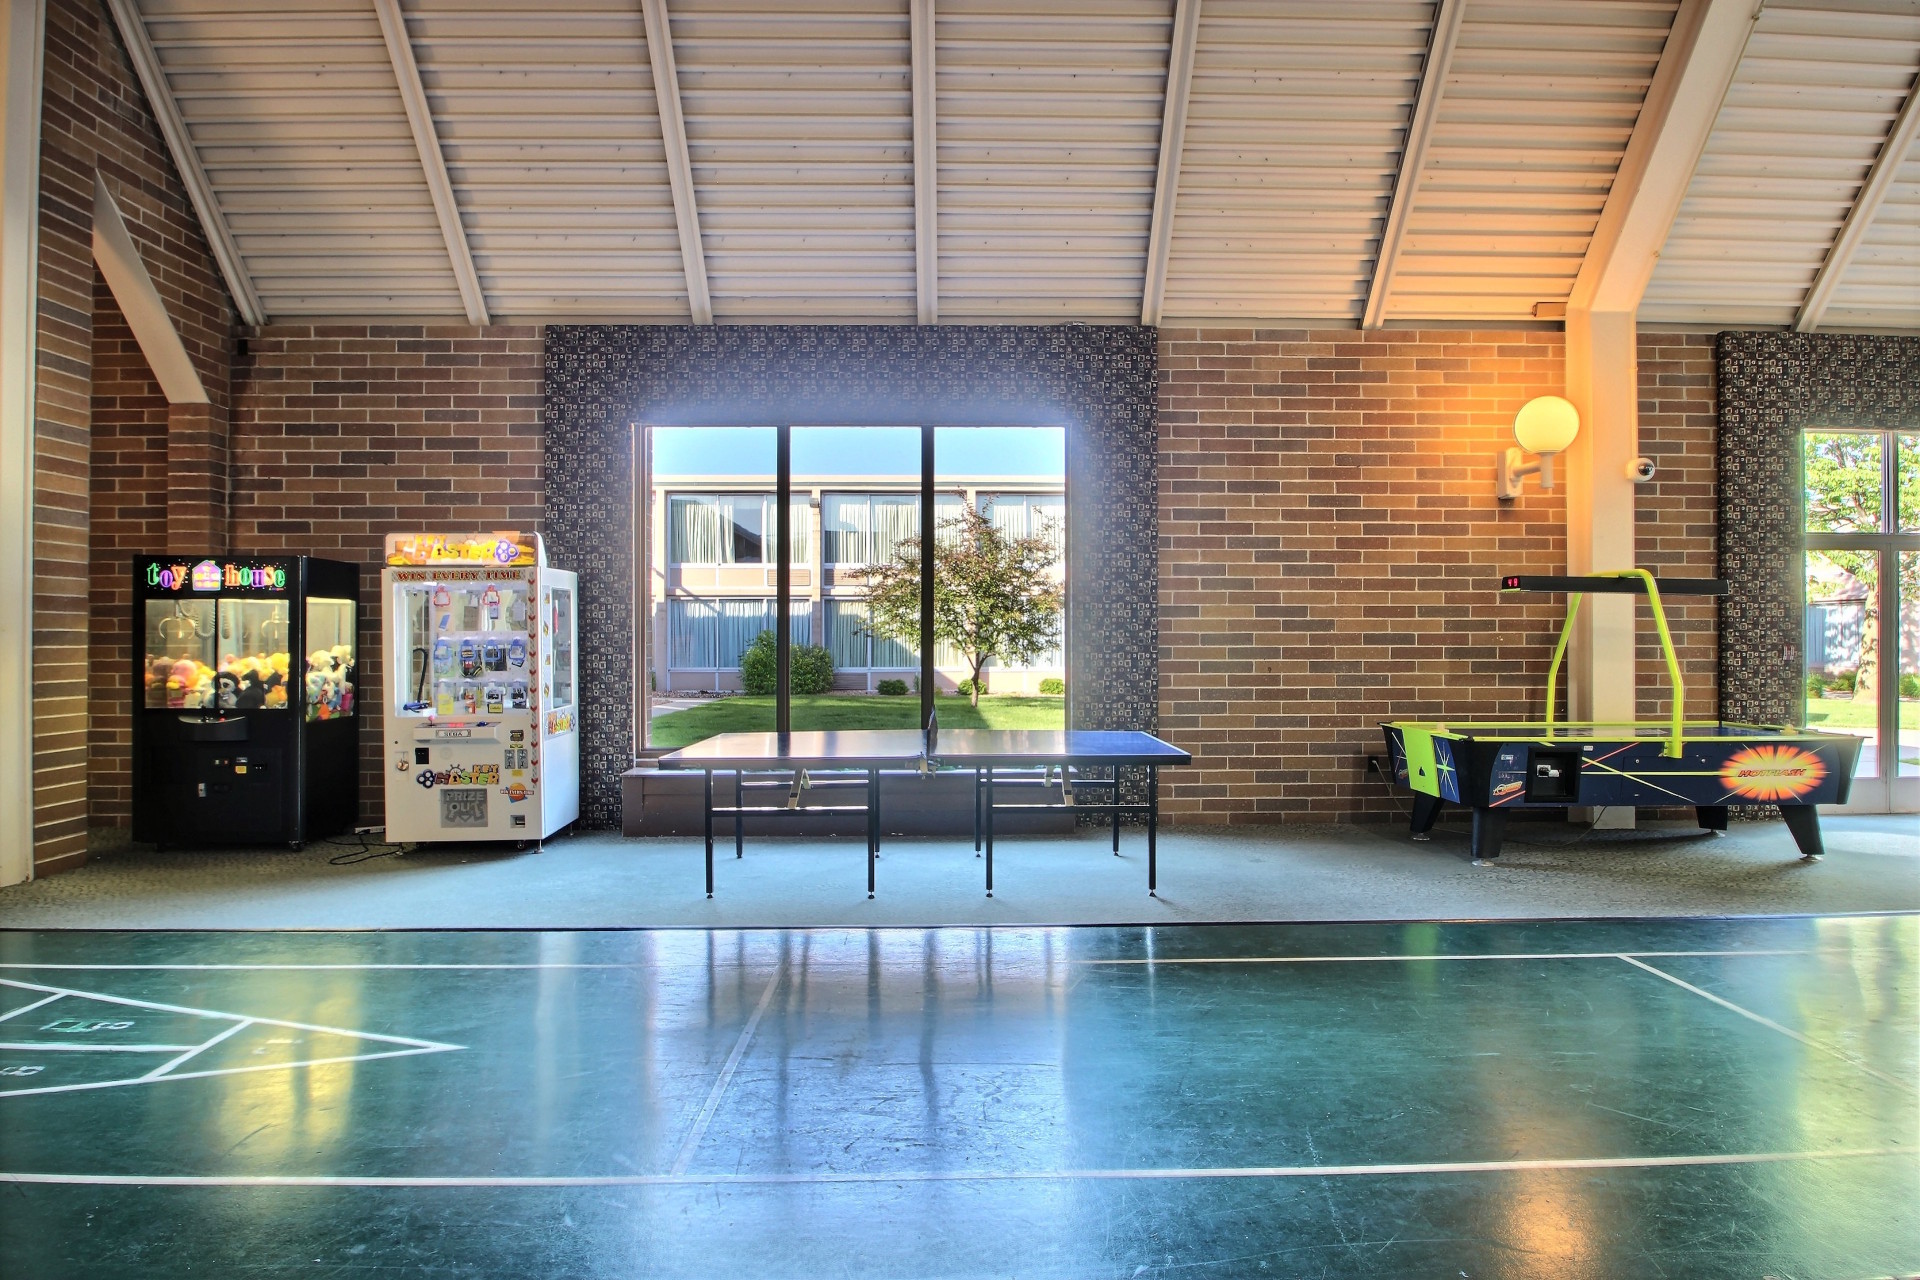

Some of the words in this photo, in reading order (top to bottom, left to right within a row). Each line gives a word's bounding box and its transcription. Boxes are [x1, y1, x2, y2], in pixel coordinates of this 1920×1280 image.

[415, 540, 499, 561] MASTER
[147, 563, 187, 590] toy
[225, 564, 286, 588] house
[398, 572, 426, 581] WIN
[432, 571, 479, 580] EVERY
[485, 570, 521, 580] TIME
[473, 764, 499, 774] KEY
[434, 771, 500, 786] MASTER
[446, 791, 486, 801] PRIZE
